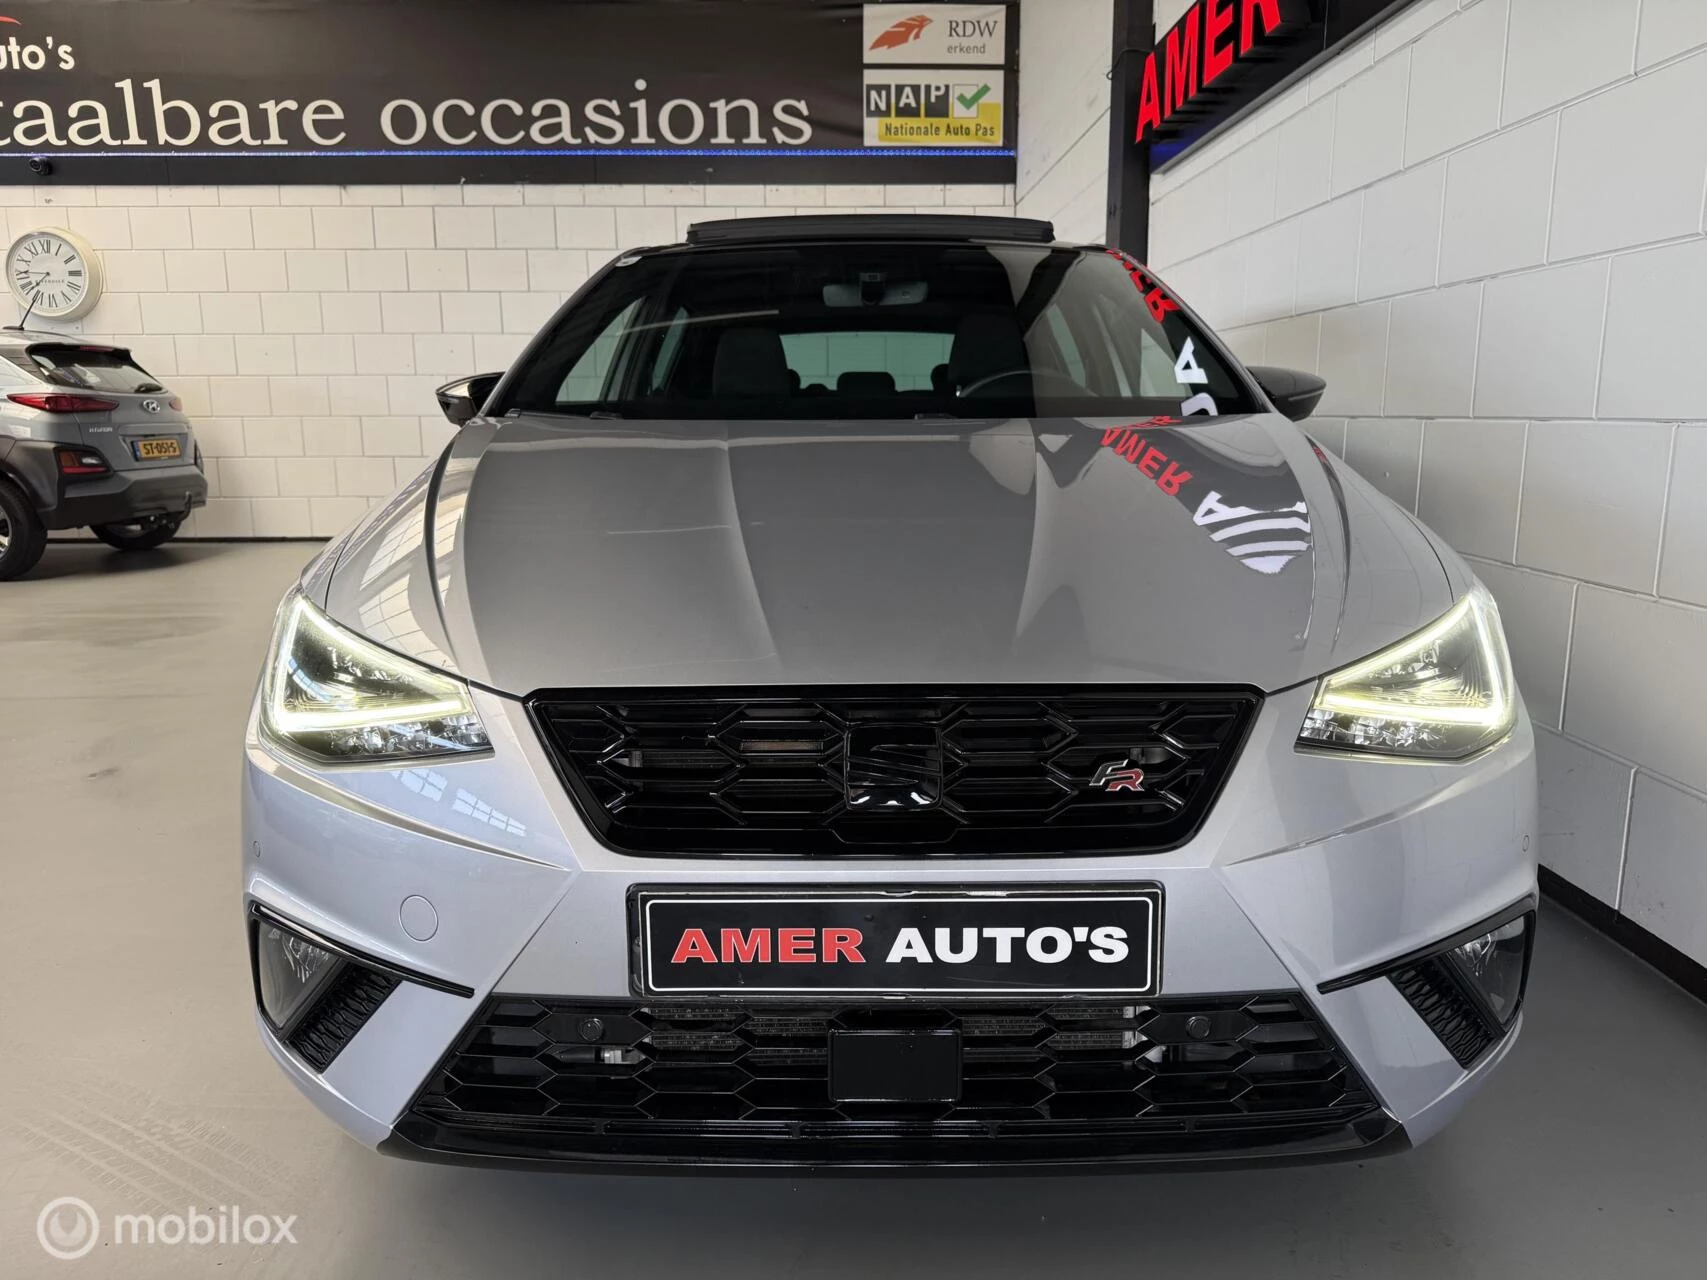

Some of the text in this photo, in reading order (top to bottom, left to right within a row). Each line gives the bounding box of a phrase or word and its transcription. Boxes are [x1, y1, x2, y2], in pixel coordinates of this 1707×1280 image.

[947, 20, 998, 38] RDW
[947, 43, 986, 54] erkend
[869, 84, 946, 112] NAP
[380, 79, 813, 146] occasions
[885, 122, 995, 137] Nationale Auto Pas
[1089, 759, 1145, 792] FR
[671, 926, 1129, 964] AMER AUTO'S
